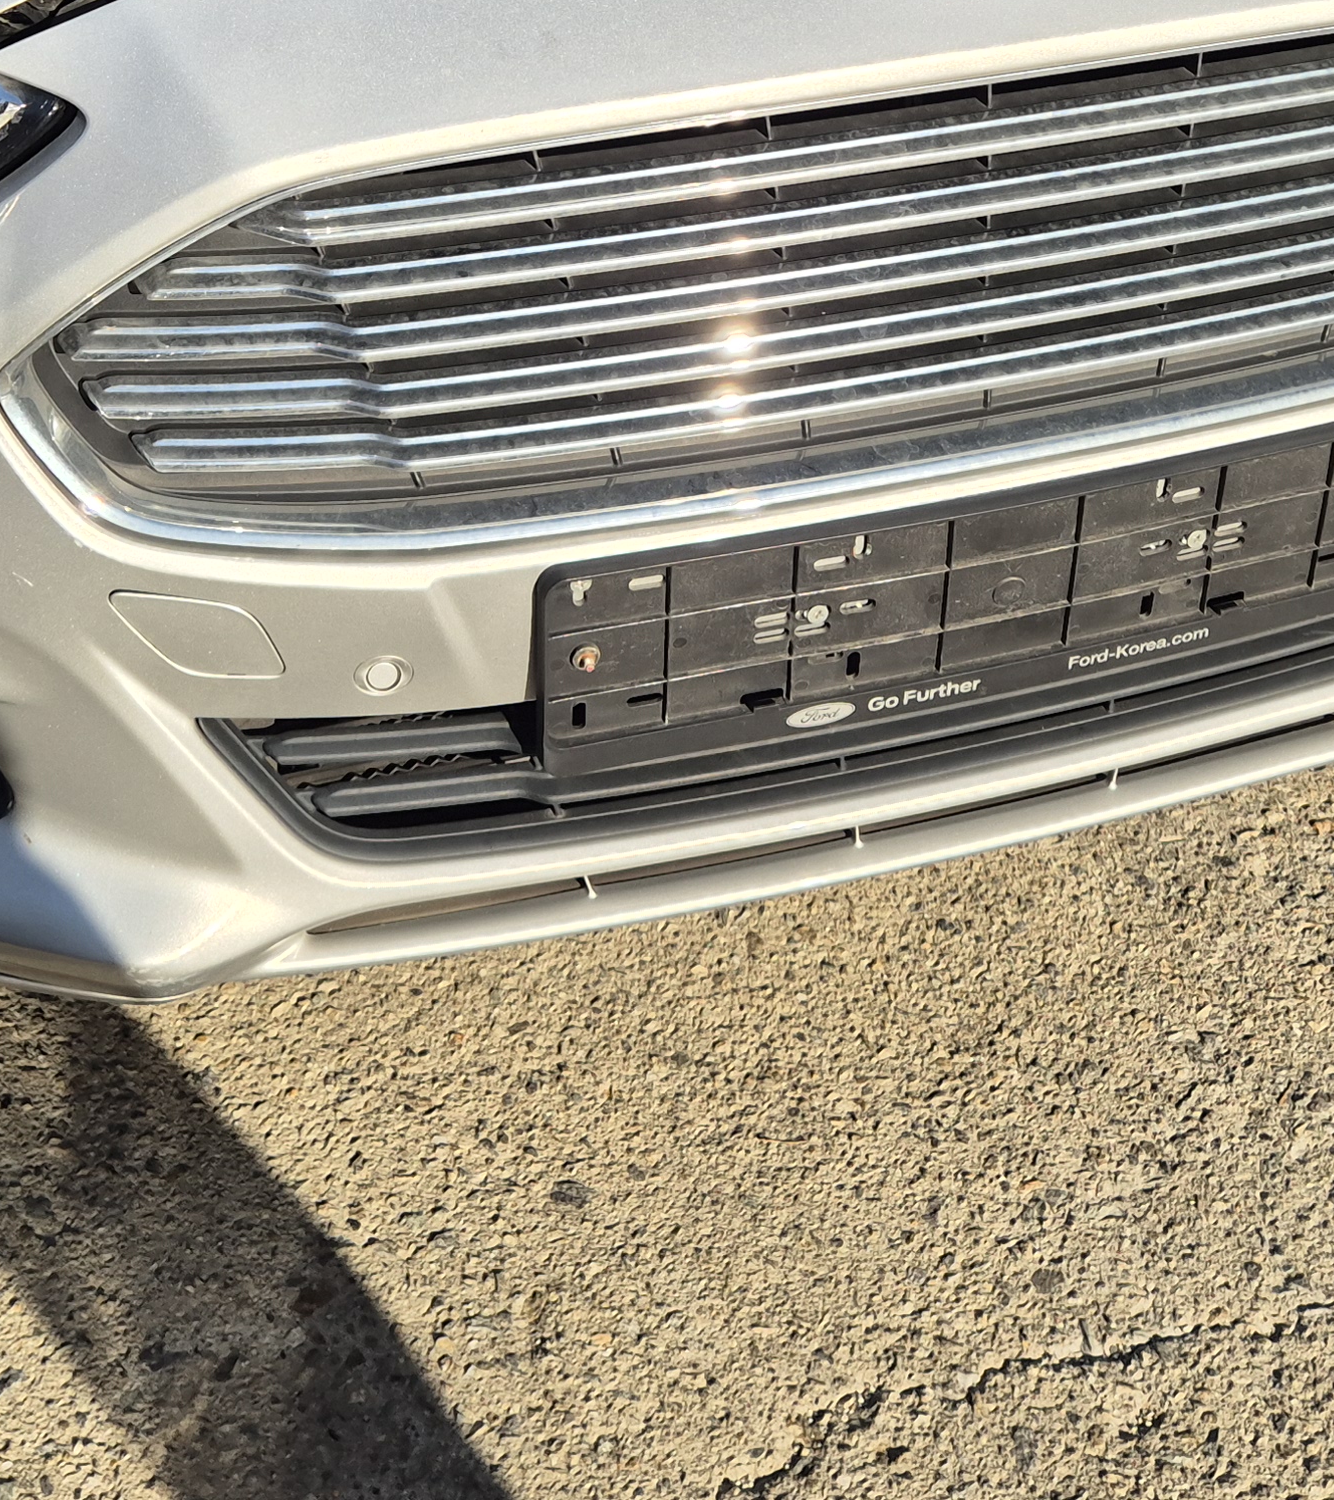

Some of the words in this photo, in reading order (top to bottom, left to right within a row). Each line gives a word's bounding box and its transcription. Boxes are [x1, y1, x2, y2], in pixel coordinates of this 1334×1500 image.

[1068, 627, 1209, 670] Ford-Korea.com
[800, 706, 841, 724] Ford
[868, 696, 899, 712] Go
[903, 679, 981, 705] Further
